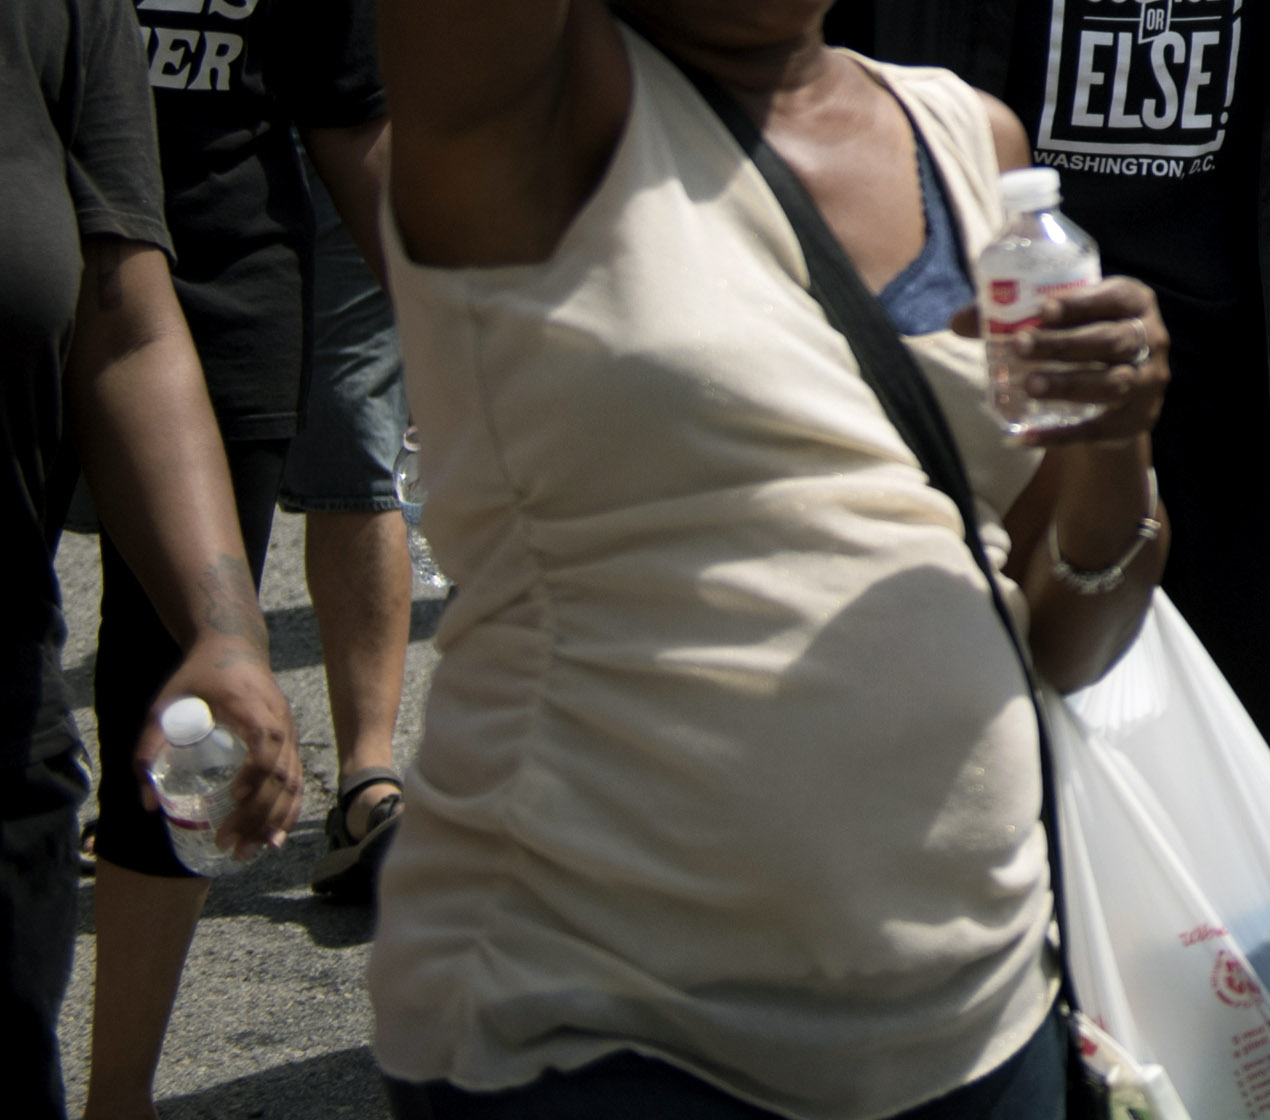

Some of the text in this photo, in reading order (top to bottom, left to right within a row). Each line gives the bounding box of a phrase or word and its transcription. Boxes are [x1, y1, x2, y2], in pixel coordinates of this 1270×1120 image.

[1146, 8, 1166, 31] OR
[1033, 150, 1216, 180] WASHINGTON, D.C.
